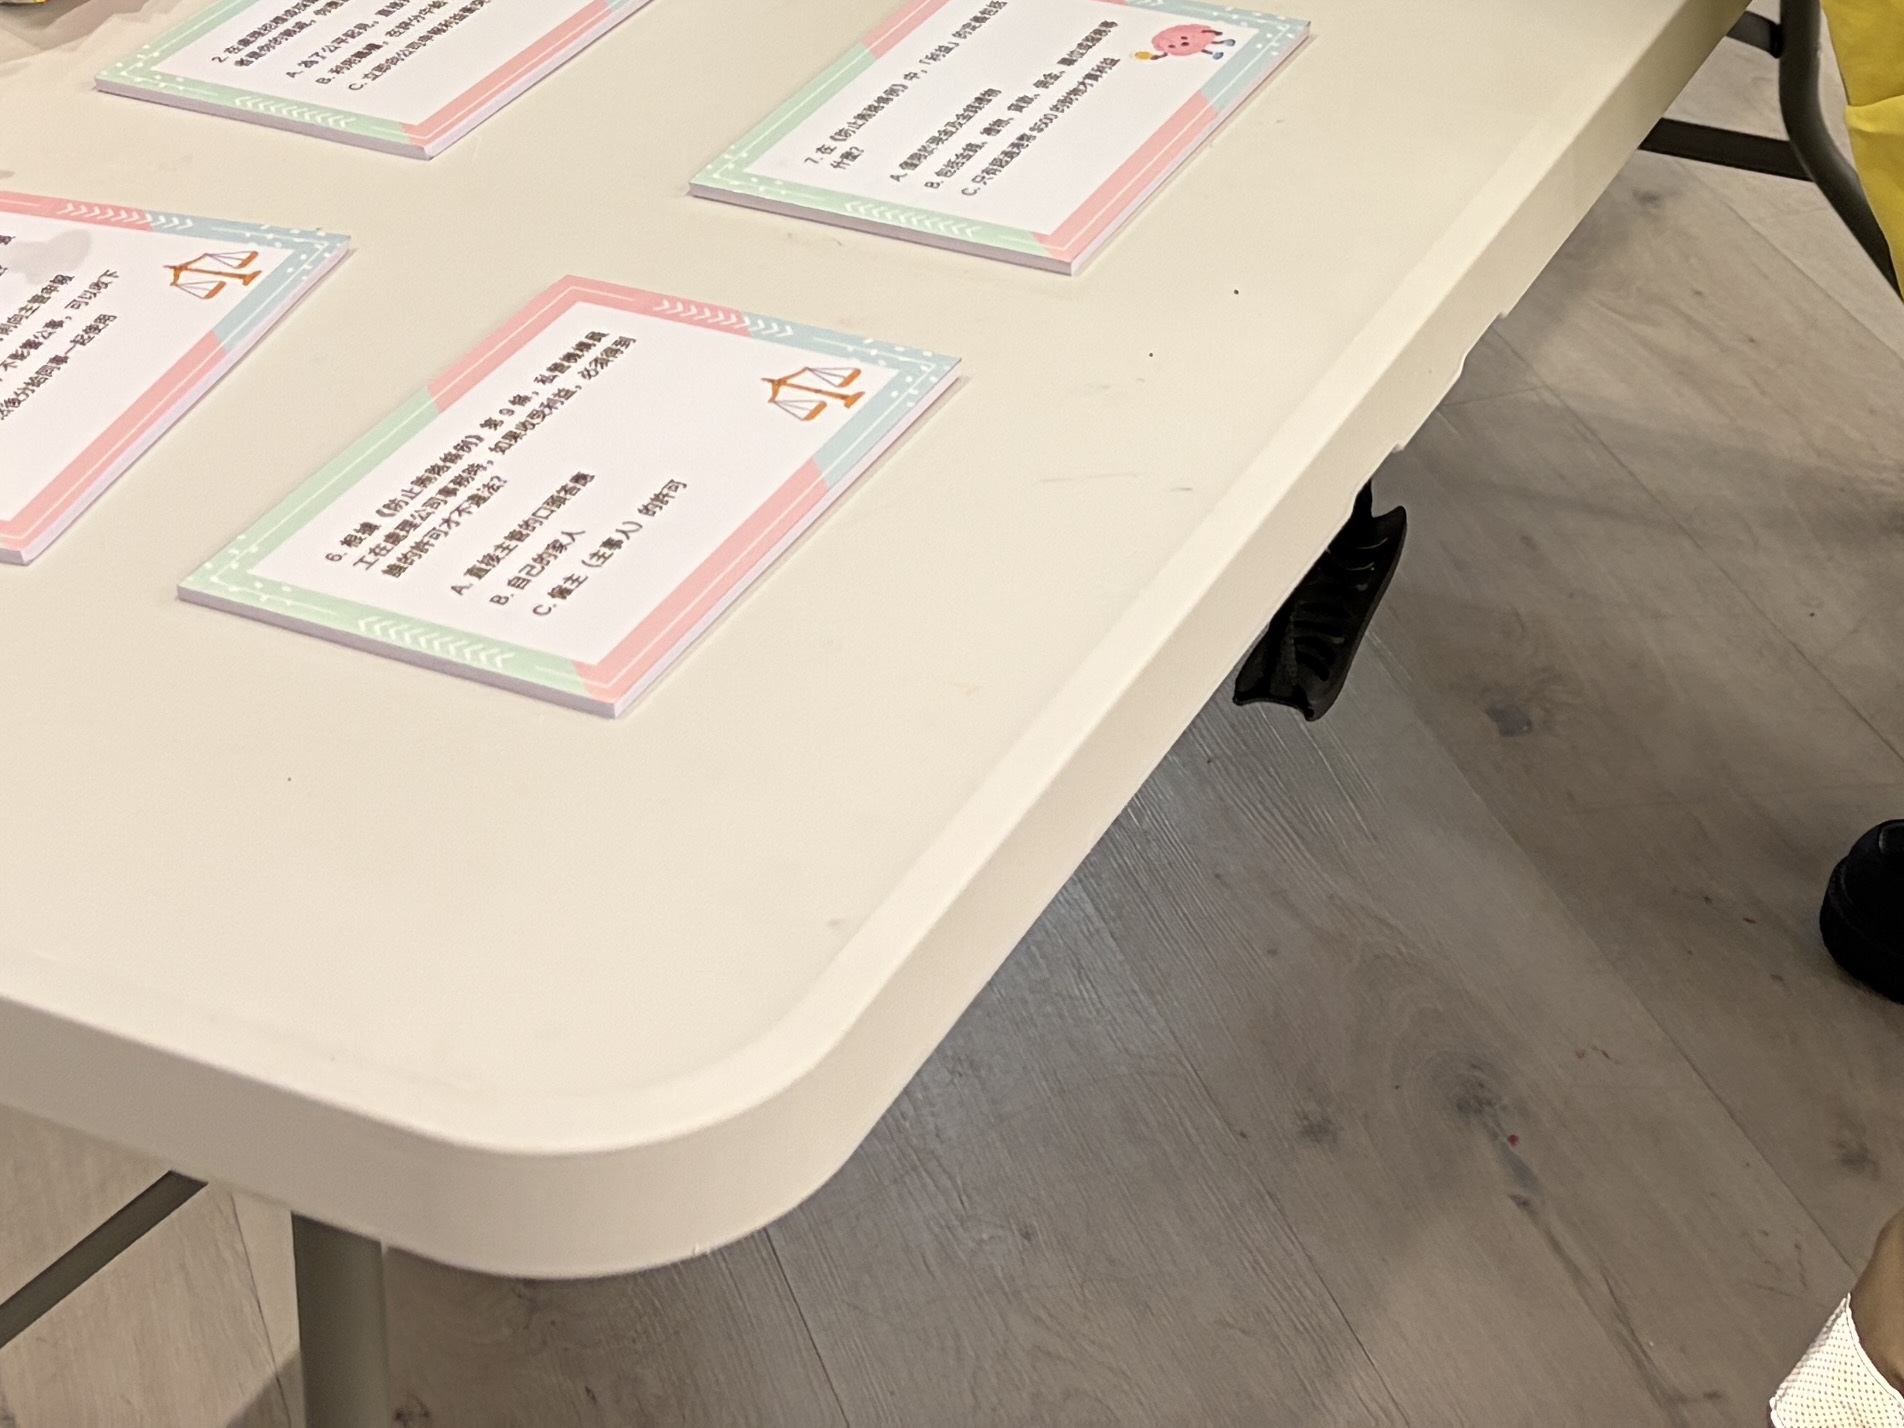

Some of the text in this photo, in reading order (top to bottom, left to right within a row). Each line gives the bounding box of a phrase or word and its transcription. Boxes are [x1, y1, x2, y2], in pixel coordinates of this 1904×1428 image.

[324, 552, 348, 562] 6.
[489, 530, 586, 606] B. 自己的家人
[450, 583, 473, 596] A.
[532, 604, 557, 616] C.
